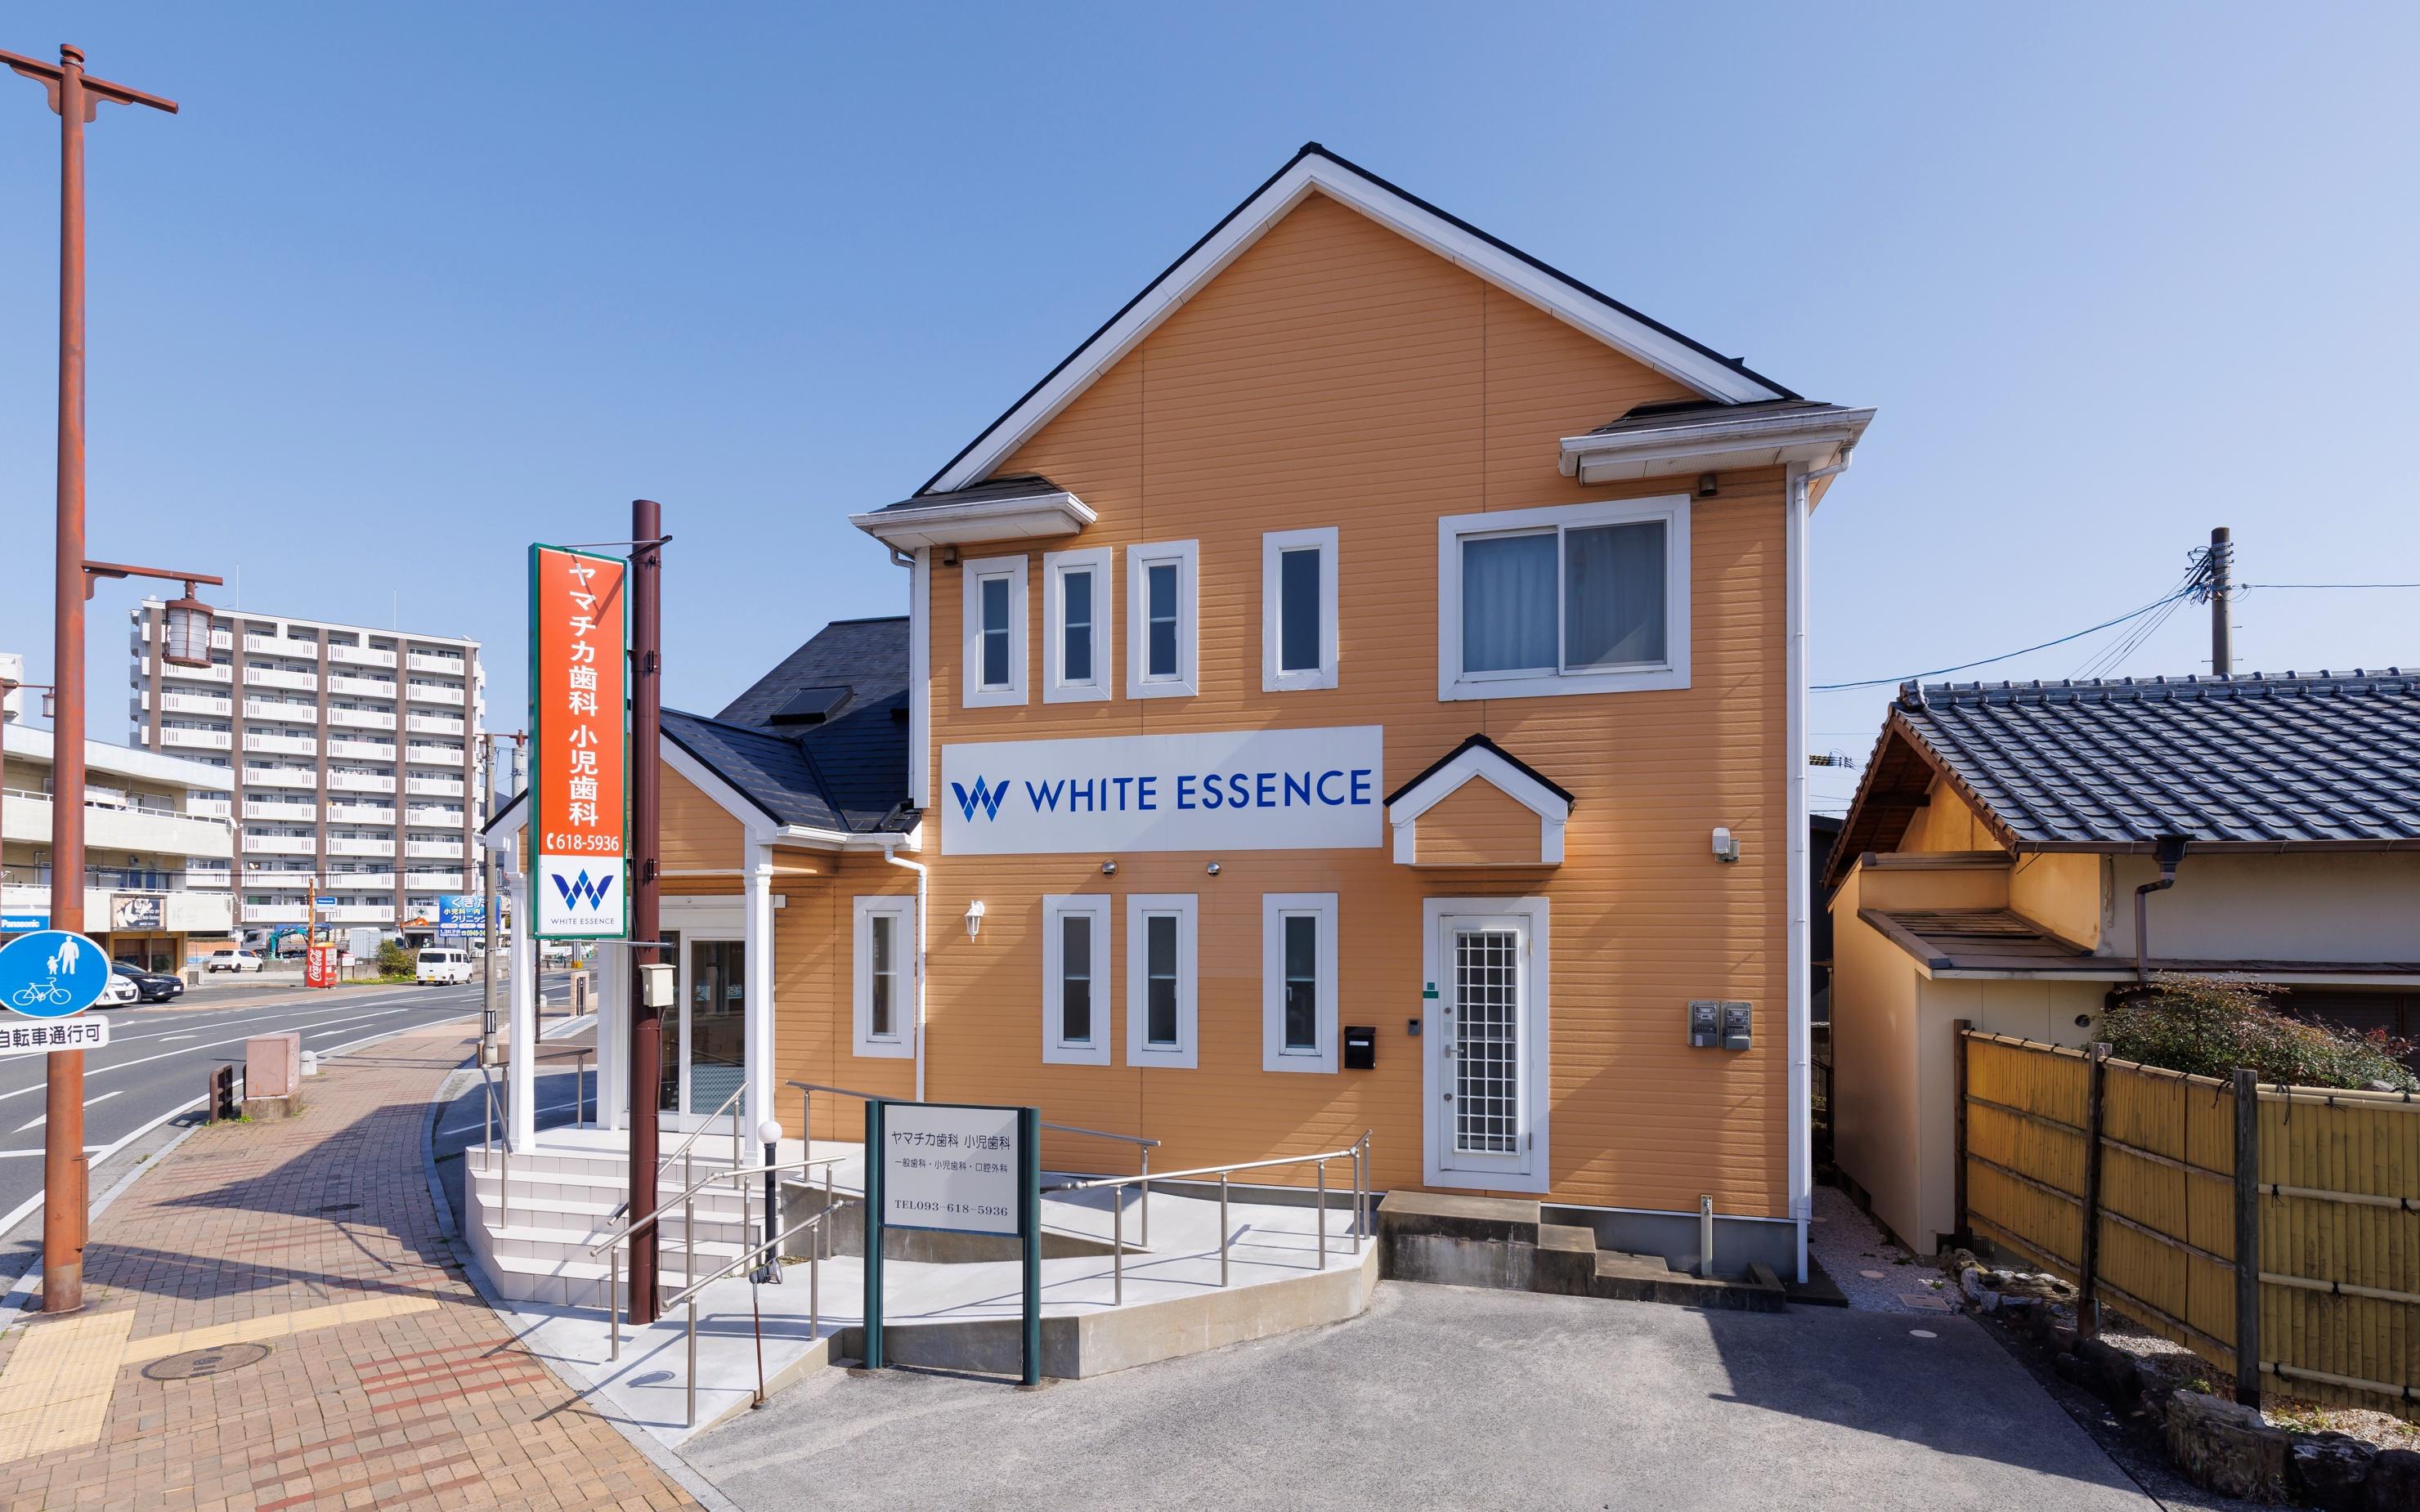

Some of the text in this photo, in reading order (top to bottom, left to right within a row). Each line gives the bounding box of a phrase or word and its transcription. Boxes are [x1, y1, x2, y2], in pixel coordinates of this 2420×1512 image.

[568, 562, 598, 827] ヤマチカ歯科 小児歯科
[1024, 776, 1157, 813] WHITE
[1176, 769, 1372, 810] ESSENCE
[556, 834, 620, 852] 618-5936
[1, 919, 40, 928] Panasonic
[309, 947, 322, 982] Coca-Cola
[0, 1023, 101, 1049] 自転車通行可
[891, 1131, 1011, 1151] ヤマチカ歯科 小児歯科
